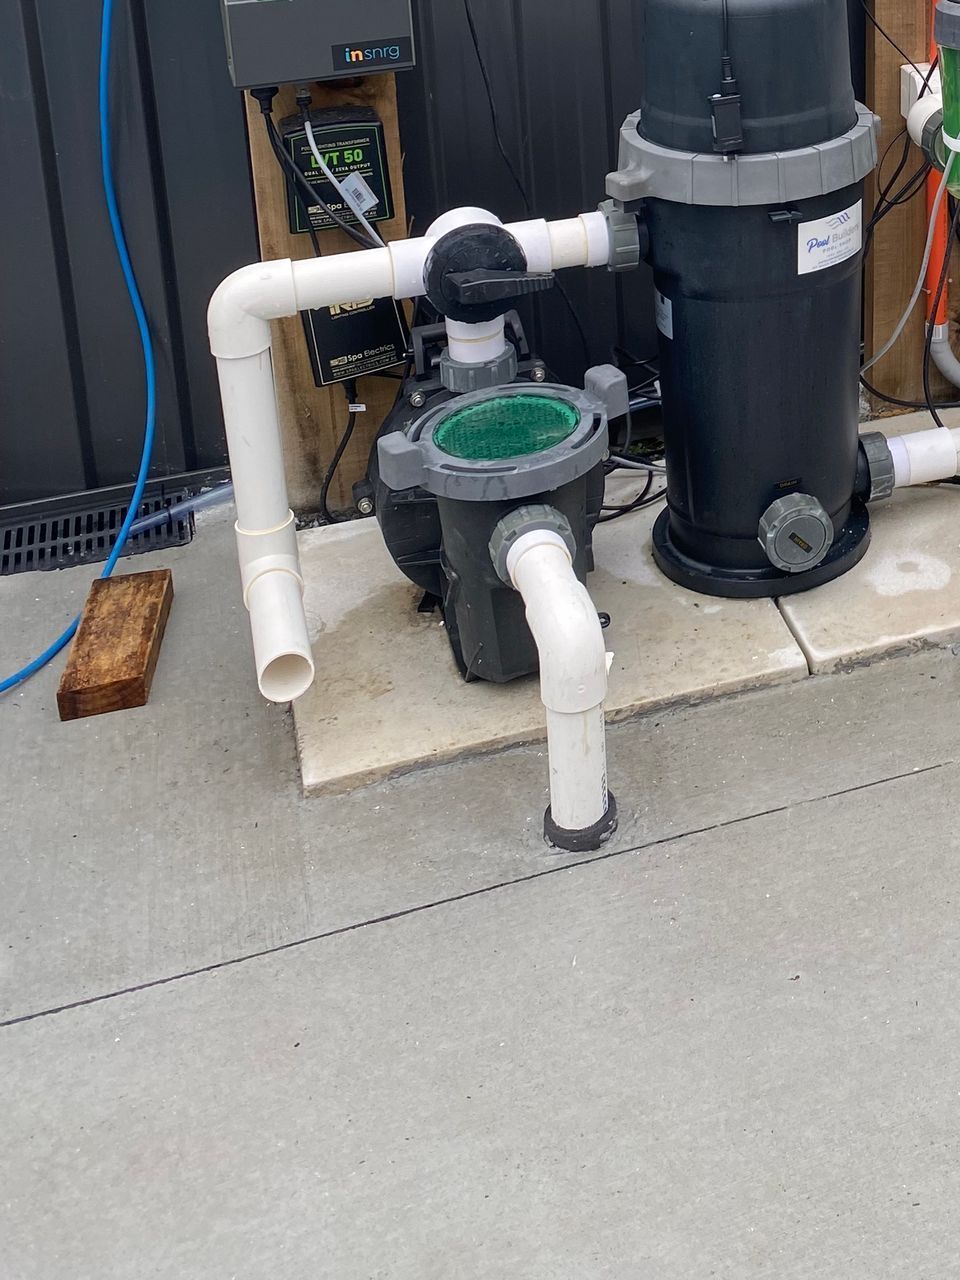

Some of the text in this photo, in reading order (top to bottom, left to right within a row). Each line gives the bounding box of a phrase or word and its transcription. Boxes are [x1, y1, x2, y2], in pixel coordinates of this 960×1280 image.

[345, 45, 400, 62] insnrg
[310, 148, 364, 168] LVT 50
[806, 235, 830, 253] Pool
[347, 353, 363, 362] Spa
[363, 343, 395, 357] Electrics
